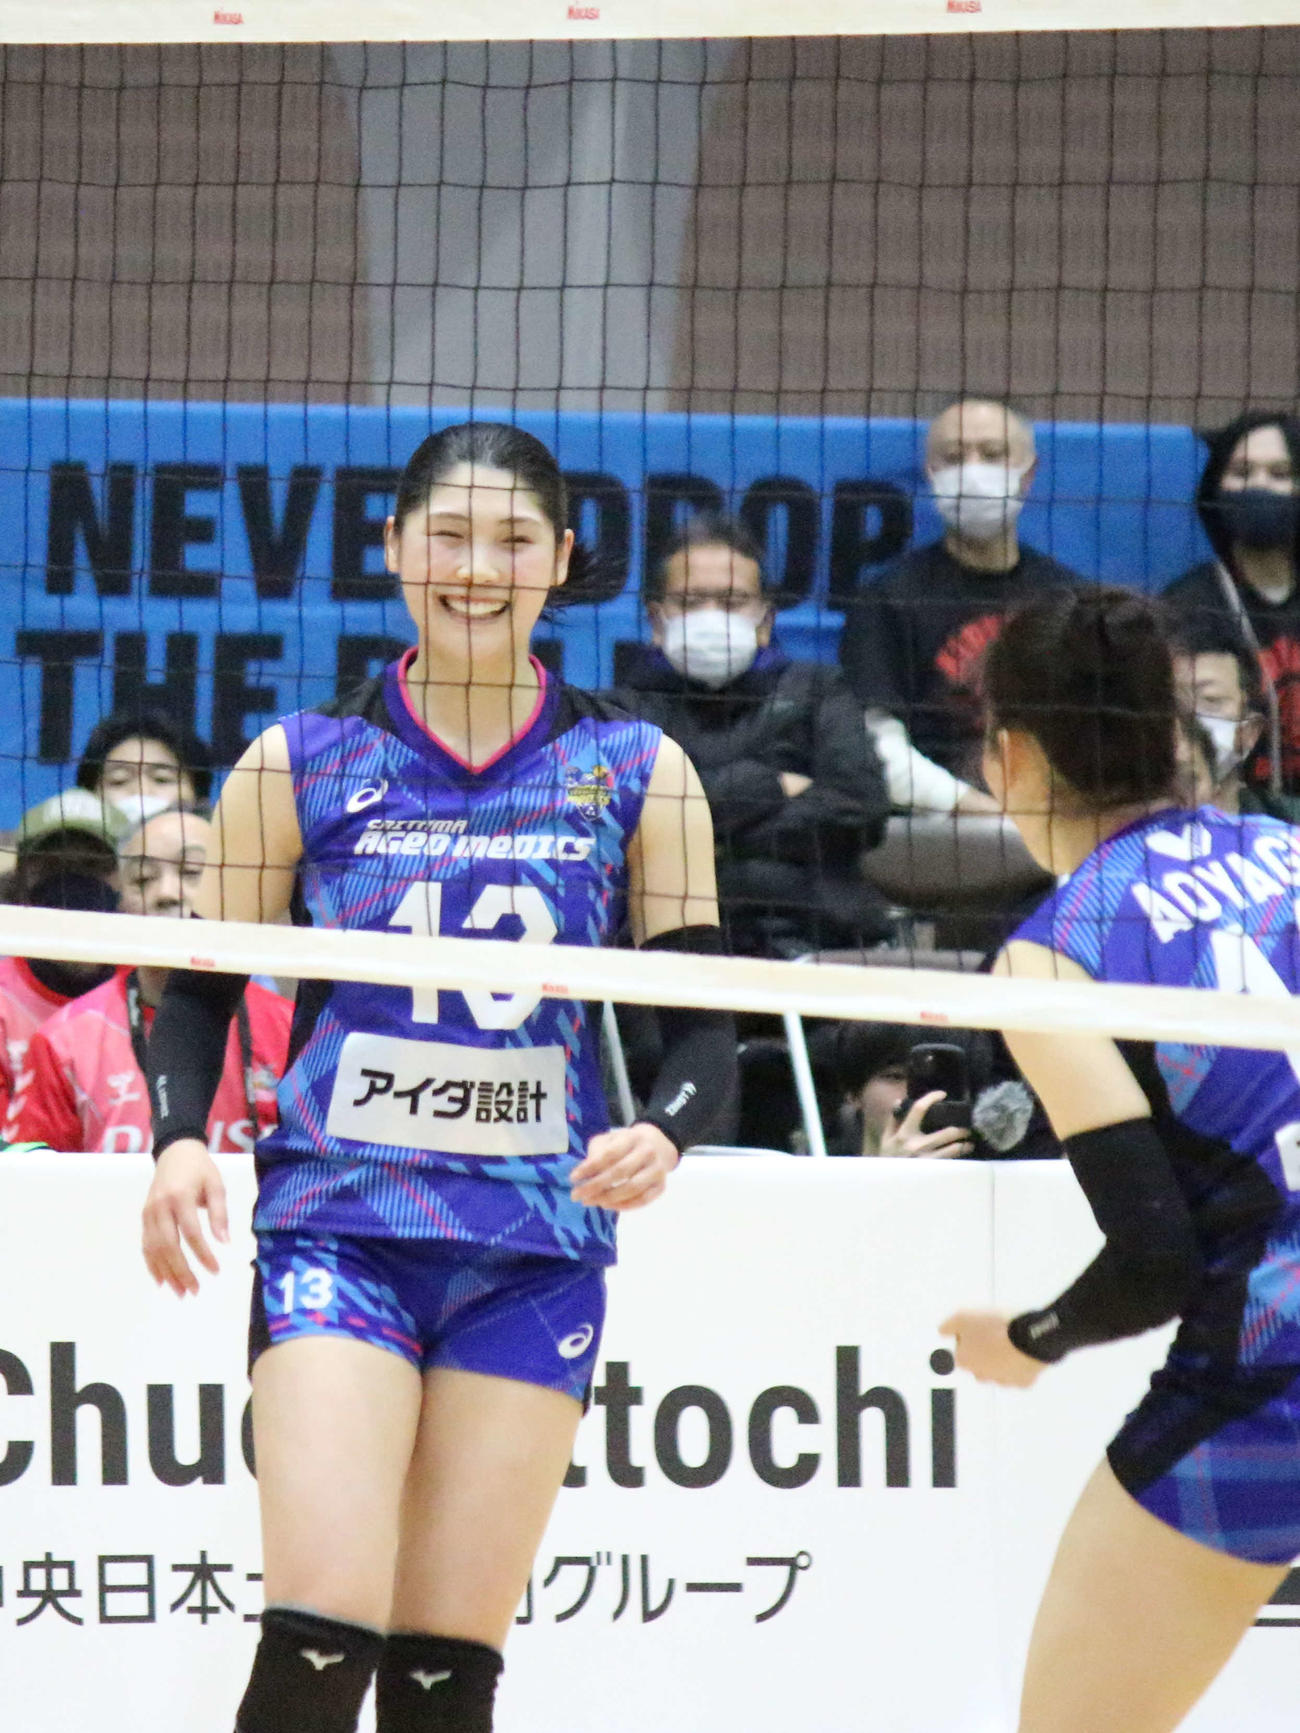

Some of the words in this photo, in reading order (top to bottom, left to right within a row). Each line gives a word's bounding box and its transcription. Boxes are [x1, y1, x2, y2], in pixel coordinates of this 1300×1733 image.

[45, 461, 404, 599] NEVE
[1130, 831, 1300, 944] AOYAG
[352, 1067, 548, 1124] アイダ設計
[279, 1267, 334, 1315] 13
